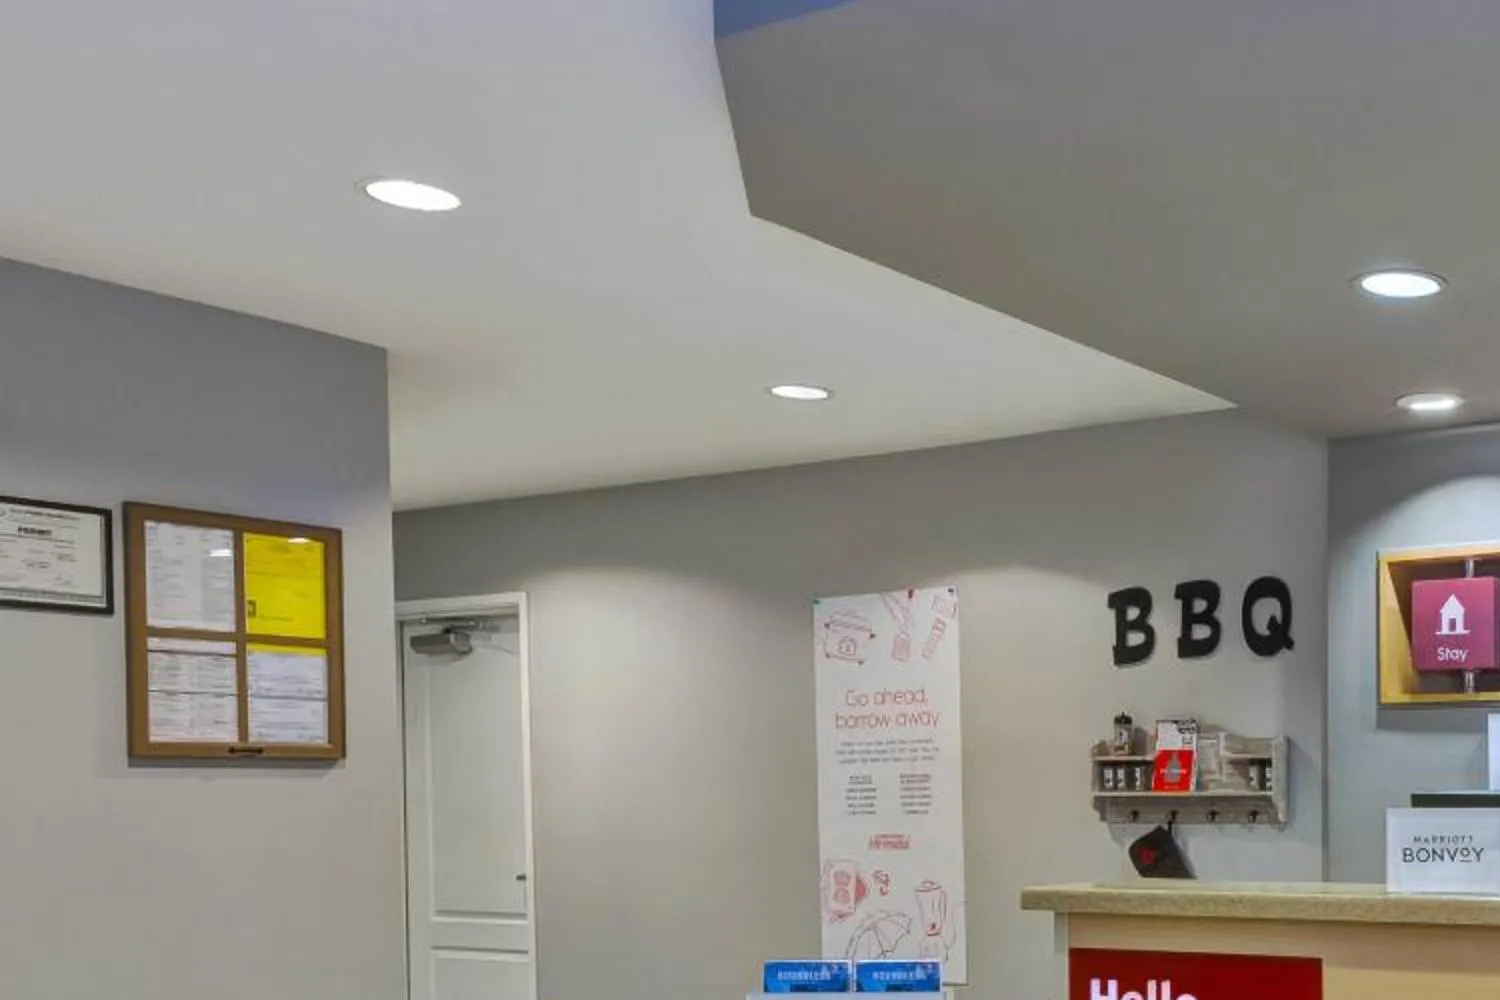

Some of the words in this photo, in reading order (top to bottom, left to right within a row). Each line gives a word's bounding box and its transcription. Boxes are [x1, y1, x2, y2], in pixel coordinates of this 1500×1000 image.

[1108, 576, 1295, 668] BBQ
[1436, 646, 1469, 665] Stay
[845, 689, 869, 706] Go
[835, 711, 891, 729] borrow
[896, 712, 941, 729] away
[1414, 835, 1474, 844] MARRIOTT
[1402, 847, 1485, 863] BONVOY
